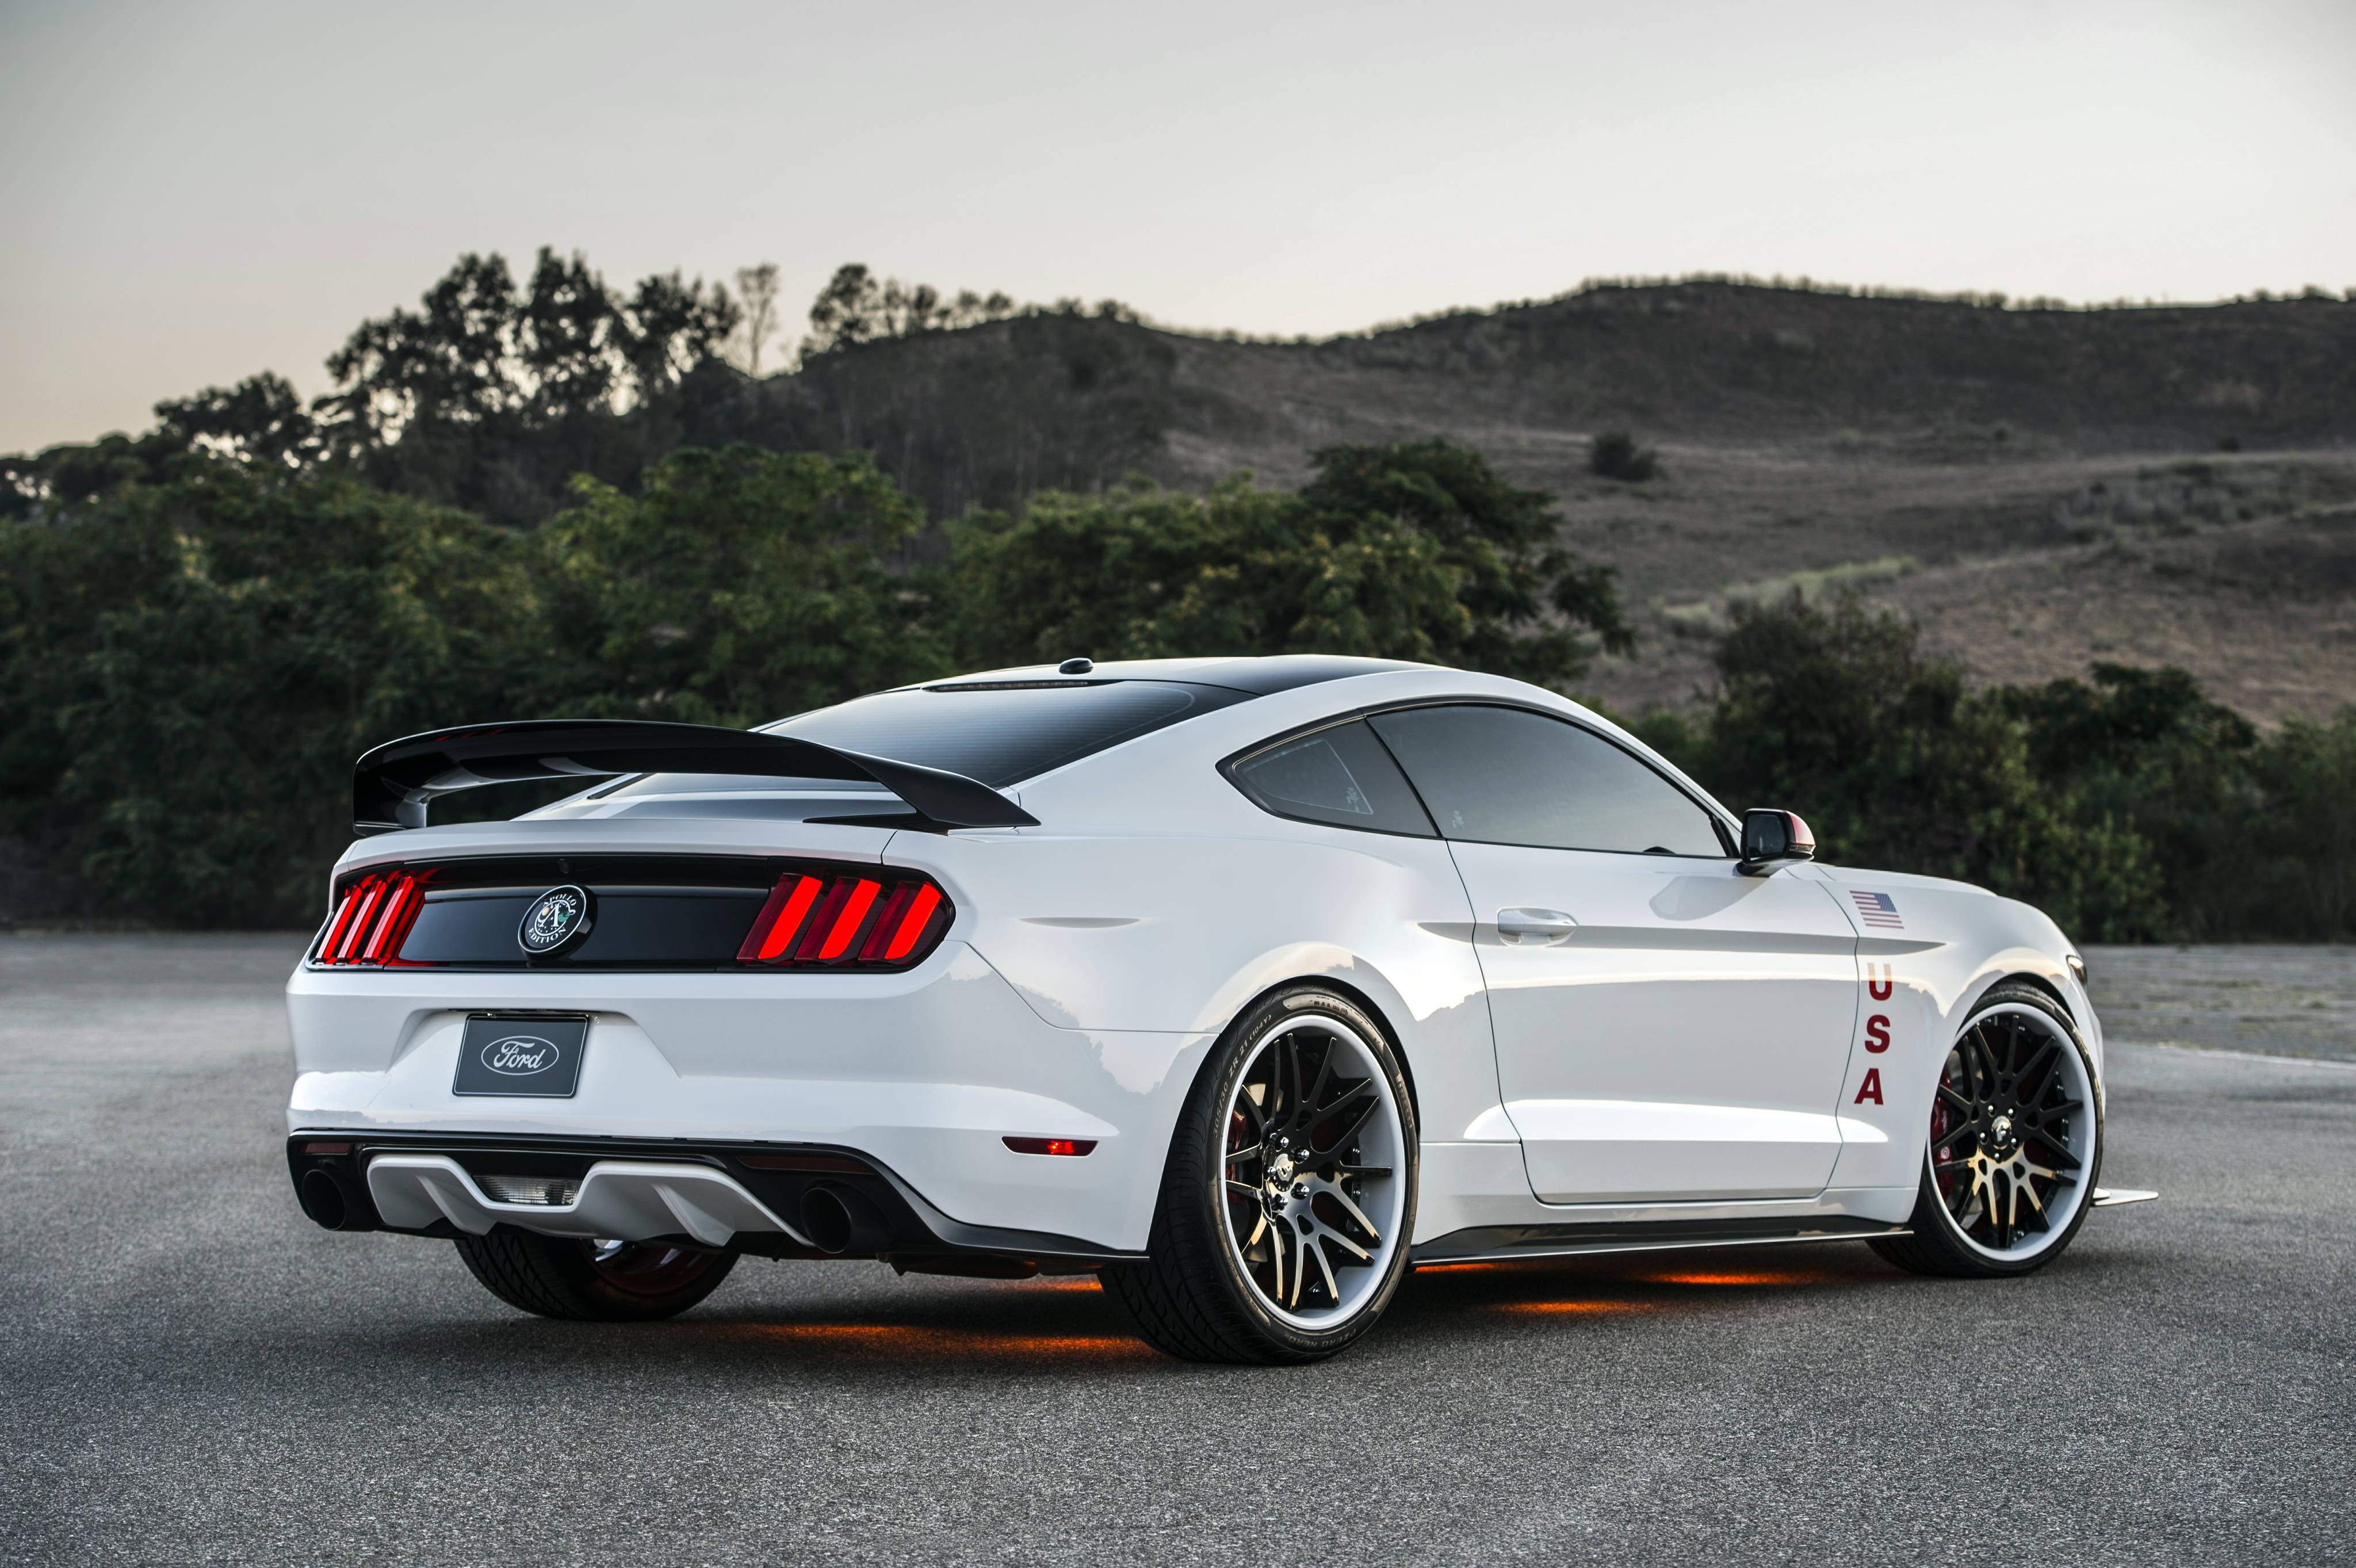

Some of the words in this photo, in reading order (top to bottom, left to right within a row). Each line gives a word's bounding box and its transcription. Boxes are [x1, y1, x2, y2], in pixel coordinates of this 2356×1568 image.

[542, 894, 576, 907] APOLLO
[529, 927, 566, 943] EDITION
[493, 1041, 546, 1069] Ford
[1213, 1081, 1228, 1138] 305/30
[1228, 1056, 1239, 1079] ZR
[1240, 1039, 1248, 1056] 21
[1249, 1014, 1272, 1041] (104Y)
